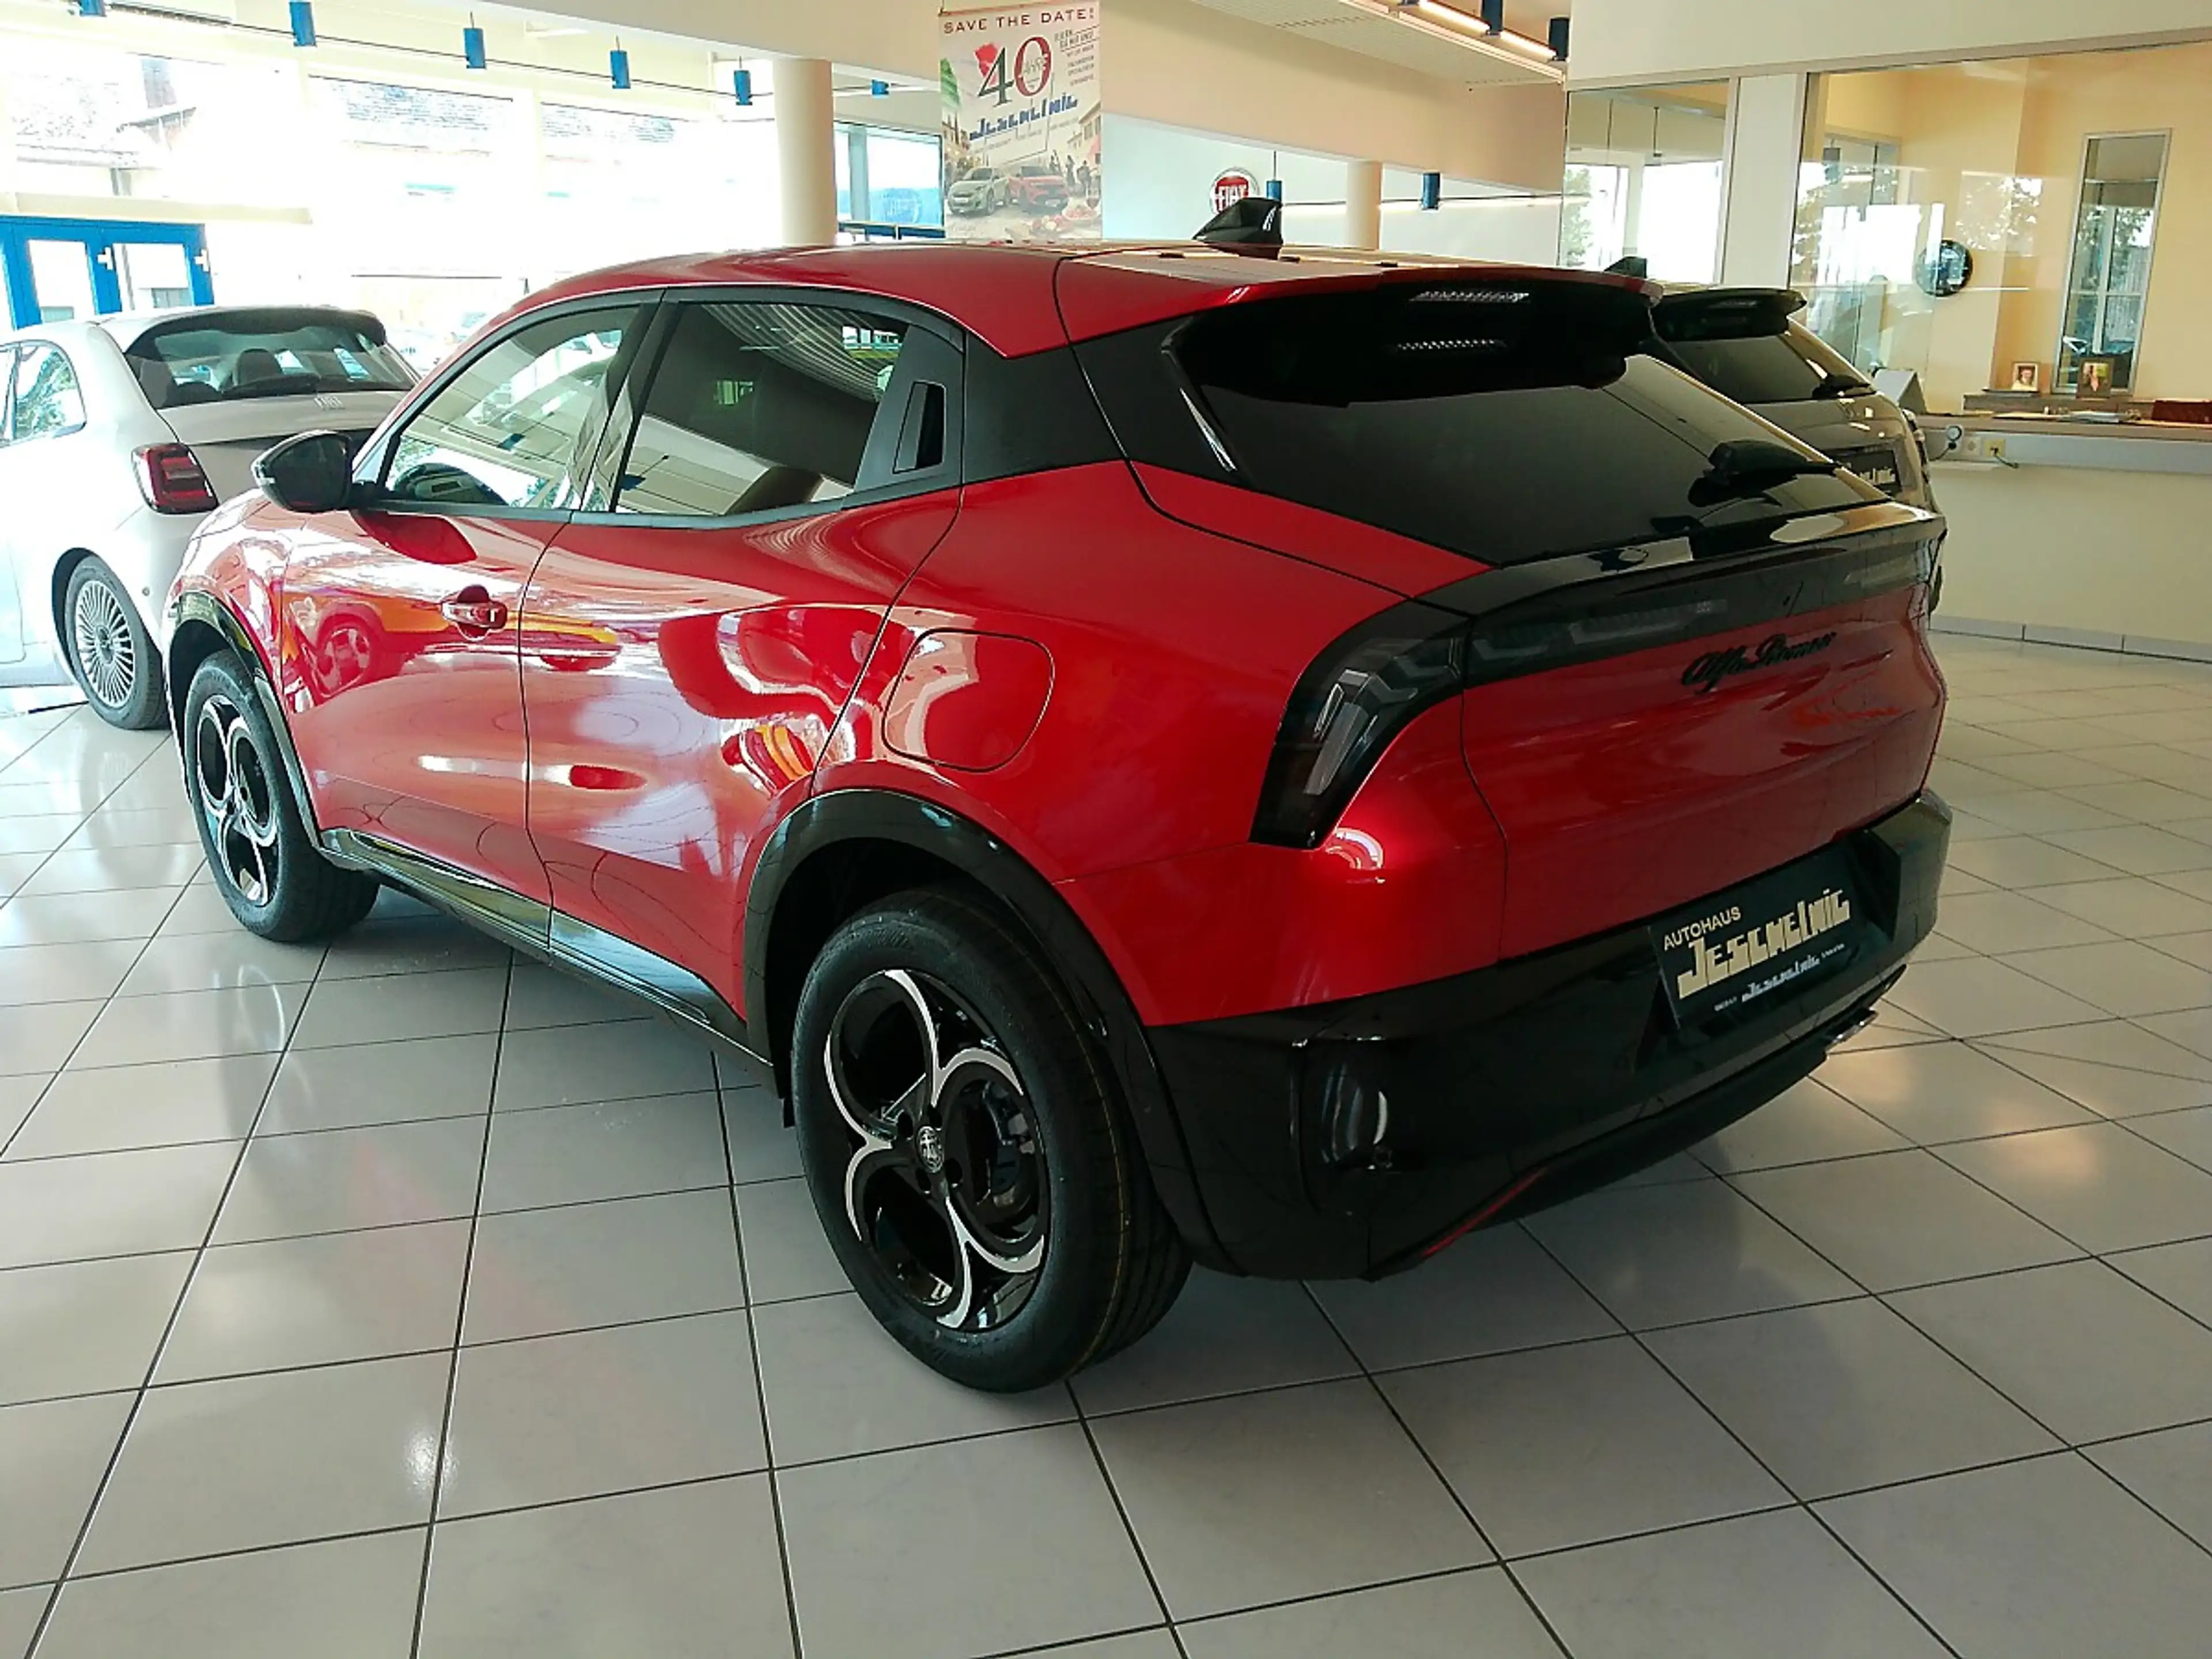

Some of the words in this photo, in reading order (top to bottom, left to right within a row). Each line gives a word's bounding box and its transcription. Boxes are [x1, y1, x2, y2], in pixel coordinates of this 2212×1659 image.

[944, 18, 987, 34] SAVE
[996, 14, 1031, 28] THE
[1041, 8, 1094, 23] DATE!
[978, 36, 1052, 108] 40
[1664, 906, 1741, 951] AUTOHAUS
